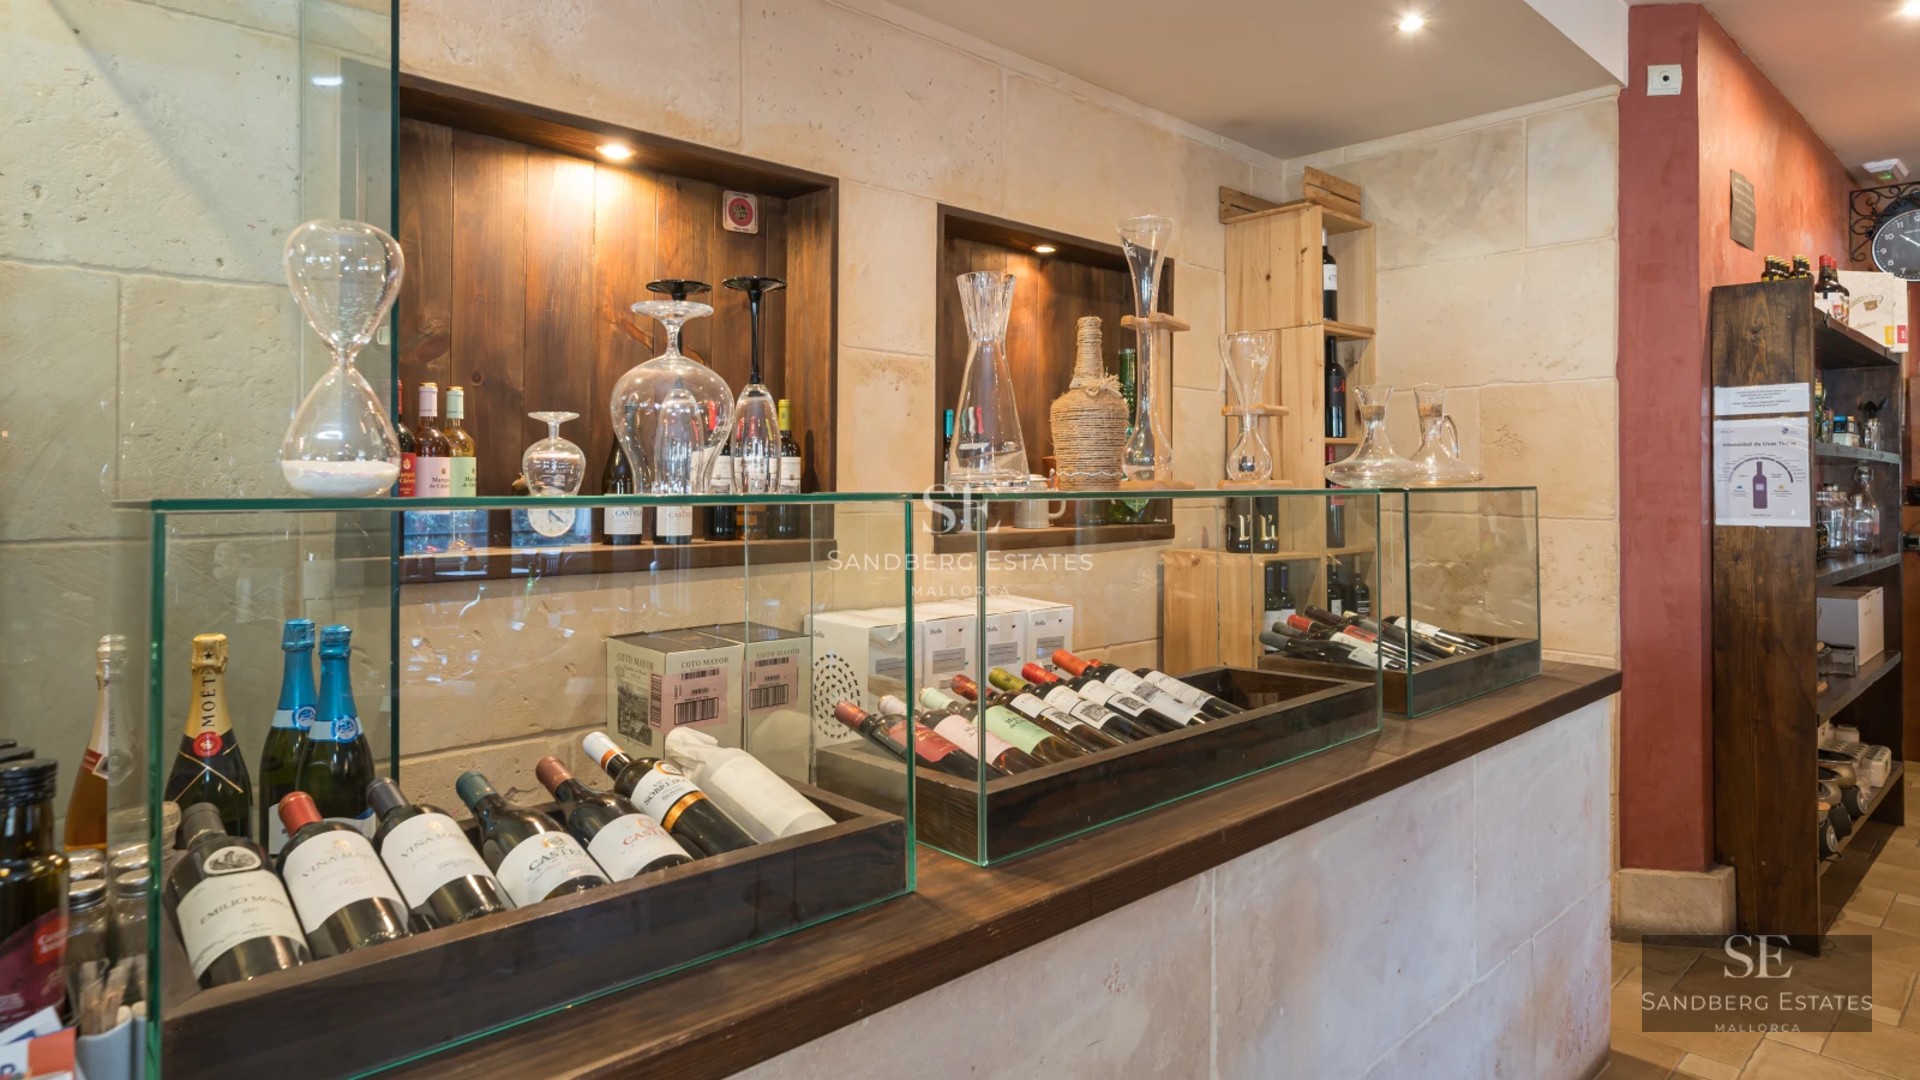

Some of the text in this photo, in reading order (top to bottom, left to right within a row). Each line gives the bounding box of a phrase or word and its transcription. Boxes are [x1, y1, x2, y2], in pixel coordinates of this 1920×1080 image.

[616, 652, 632, 664] COTO
[776, 648, 800, 657] MAYOR
[681, 657, 729, 669] COTO MAYOR
[199, 675, 216, 728] MOËT
[199, 895, 249, 926] EMILIO
